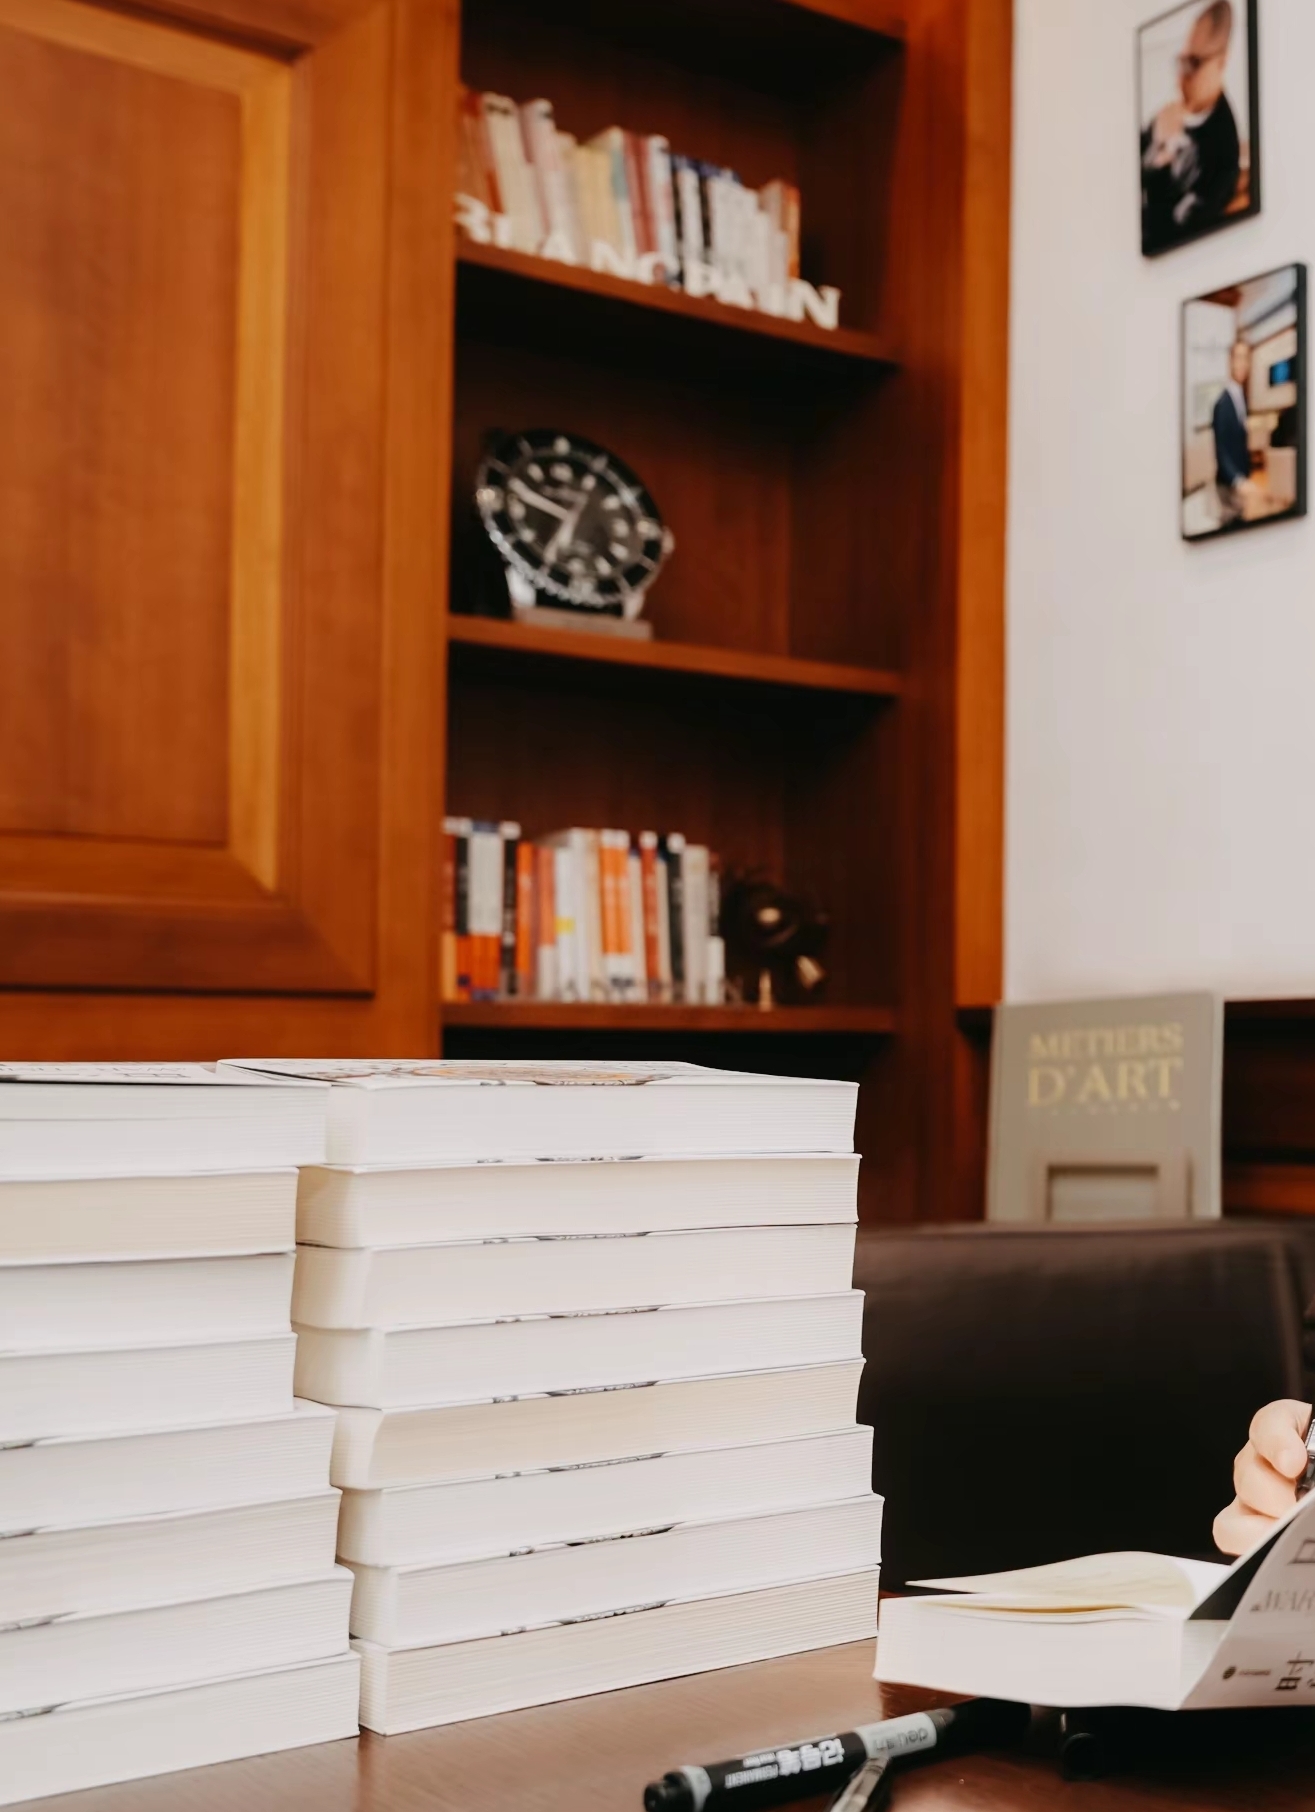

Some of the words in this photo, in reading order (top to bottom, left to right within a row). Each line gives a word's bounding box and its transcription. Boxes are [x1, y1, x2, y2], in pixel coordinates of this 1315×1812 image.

[1027, 1056, 1184, 1107] D'ART
[776, 1738, 845, 1776] 记号笔
